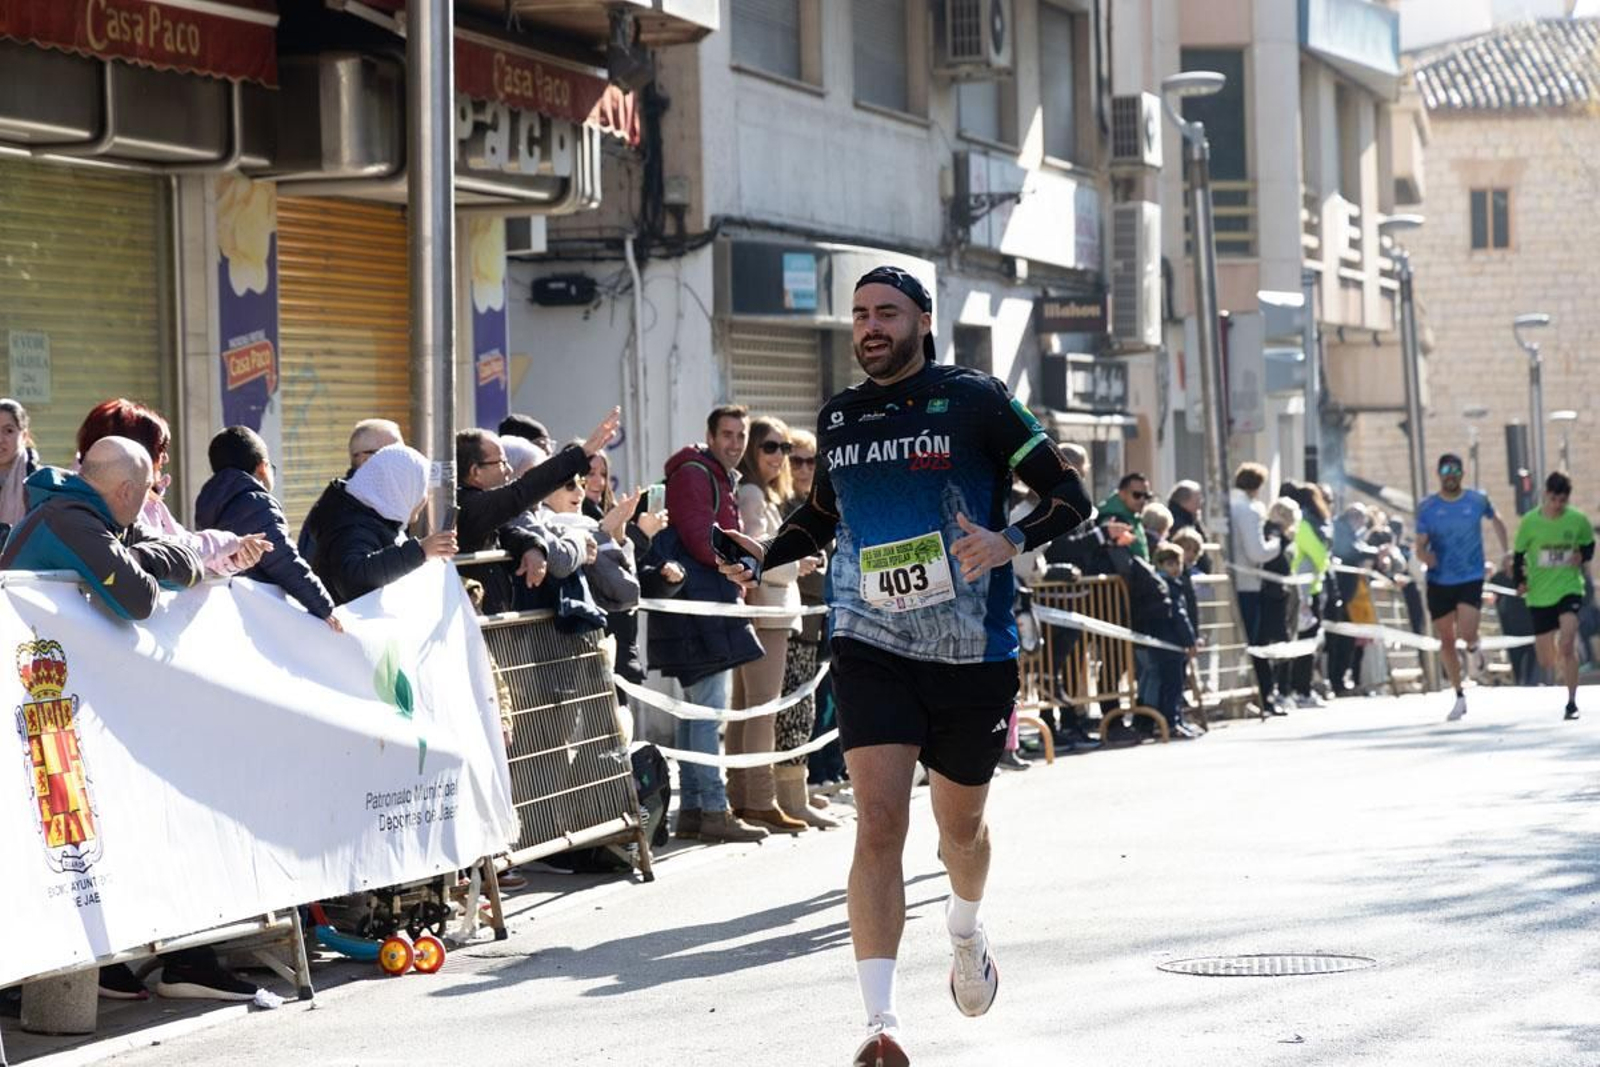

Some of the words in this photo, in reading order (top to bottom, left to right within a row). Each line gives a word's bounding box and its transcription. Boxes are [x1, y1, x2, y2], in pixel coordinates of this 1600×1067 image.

[86, 0, 145, 51] Casa
[148, 4, 200, 57] Paco
[493, 52, 533, 98] Casa
[534, 64, 570, 107] Paco
[229, 355, 251, 377] Casa
[250, 347, 271, 370] Paco
[826, 442, 860, 472] SAN
[865, 428, 950, 463] ANTÓN
[909, 450, 953, 470] 2025
[878, 563, 929, 597] 403
[365, 787, 412, 810] Patronato
